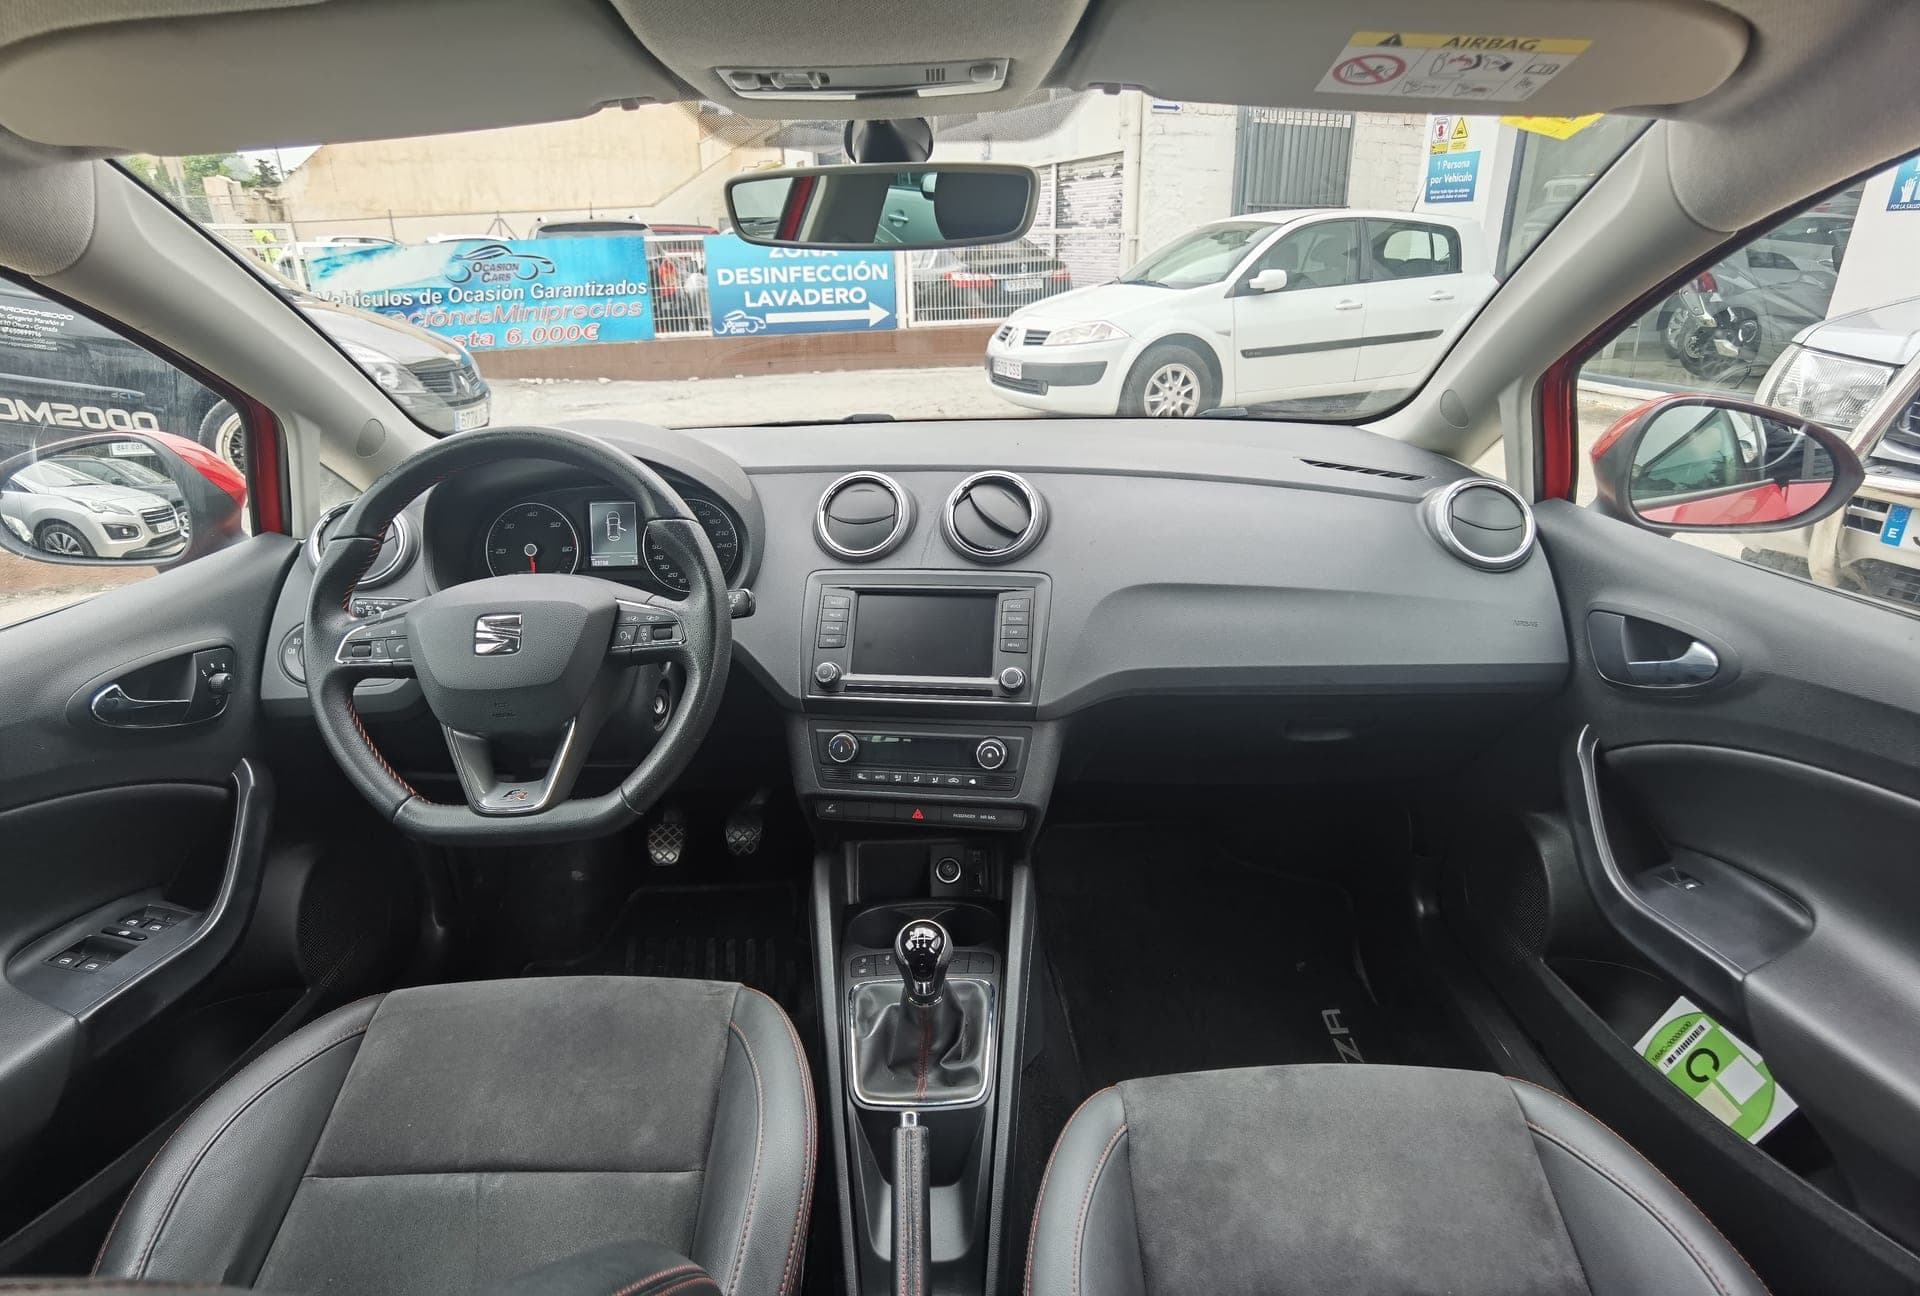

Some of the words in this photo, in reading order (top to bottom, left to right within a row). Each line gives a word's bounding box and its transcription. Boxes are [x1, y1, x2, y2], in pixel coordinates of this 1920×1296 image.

[1441, 36, 1541, 50] AIRBAG
[1443, 160, 1470, 170] Persona
[1430, 176, 1442, 186] por
[716, 260, 889, 286] DESINFECCIÓN
[419, 286, 444, 305] de
[448, 285, 524, 303] Ocasión
[530, 278, 648, 299] Garantizados
[744, 287, 867, 307] LAVADERO
[505, 323, 601, 346] 6.000€
[1887, 527, 1900, 539] E
[1685, 1047, 1720, 1083] C
